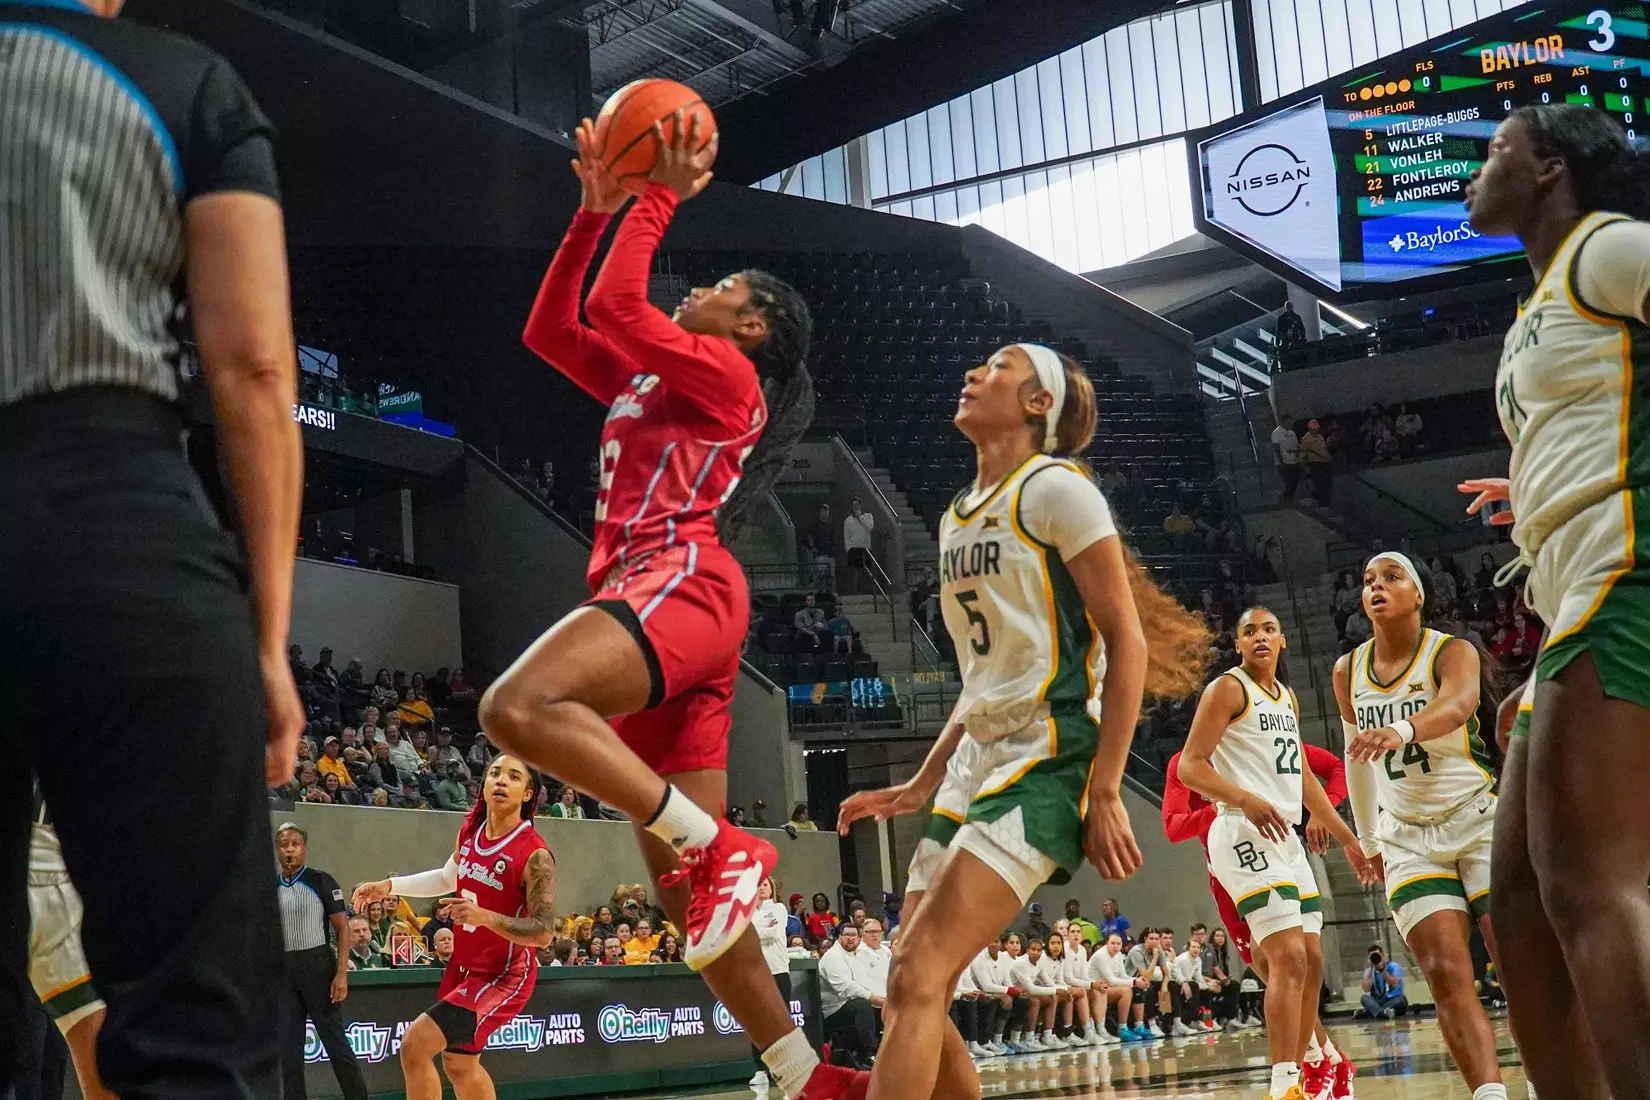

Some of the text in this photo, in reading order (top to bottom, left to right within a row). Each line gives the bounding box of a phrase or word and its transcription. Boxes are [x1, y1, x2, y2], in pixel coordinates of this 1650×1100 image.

[1586, 10, 1615, 52] 3
[1415, 61, 1434, 72] FLS
[1480, 35, 1564, 73] BAYLOR
[1422, 76, 1430, 87] 0
[1496, 58, 1626, 91] PTS REB AST PF
[1344, 92, 1357, 102] TO
[1349, 101, 1415, 122] ON THE FLOOR
[1365, 77, 1627, 140] 5 LITTLEPAGE-BUGGS 0 0 0 0
[1364, 95, 1630, 157] 11 WALKER 0
[1365, 112, 1632, 174] 21 VONLEH 0
[1367, 129, 1635, 191] 22 FONTLEROY 0
[1227, 166, 1310, 194] NISSAN
[1369, 180, 1460, 207] 24 ANDREWS
[954, 589, 991, 656] 5
[1259, 713, 1297, 734] BAYLOR
[1273, 737, 1302, 775] 22
[1384, 743, 1432, 781] 24
[545, 1028, 585, 1045] PARTS
[548, 1013, 581, 1029] AUTO
[601, 1006, 669, 1039] O'Reilly
[674, 1006, 701, 1021] AUTO
[671, 1021, 705, 1036] PARTS
